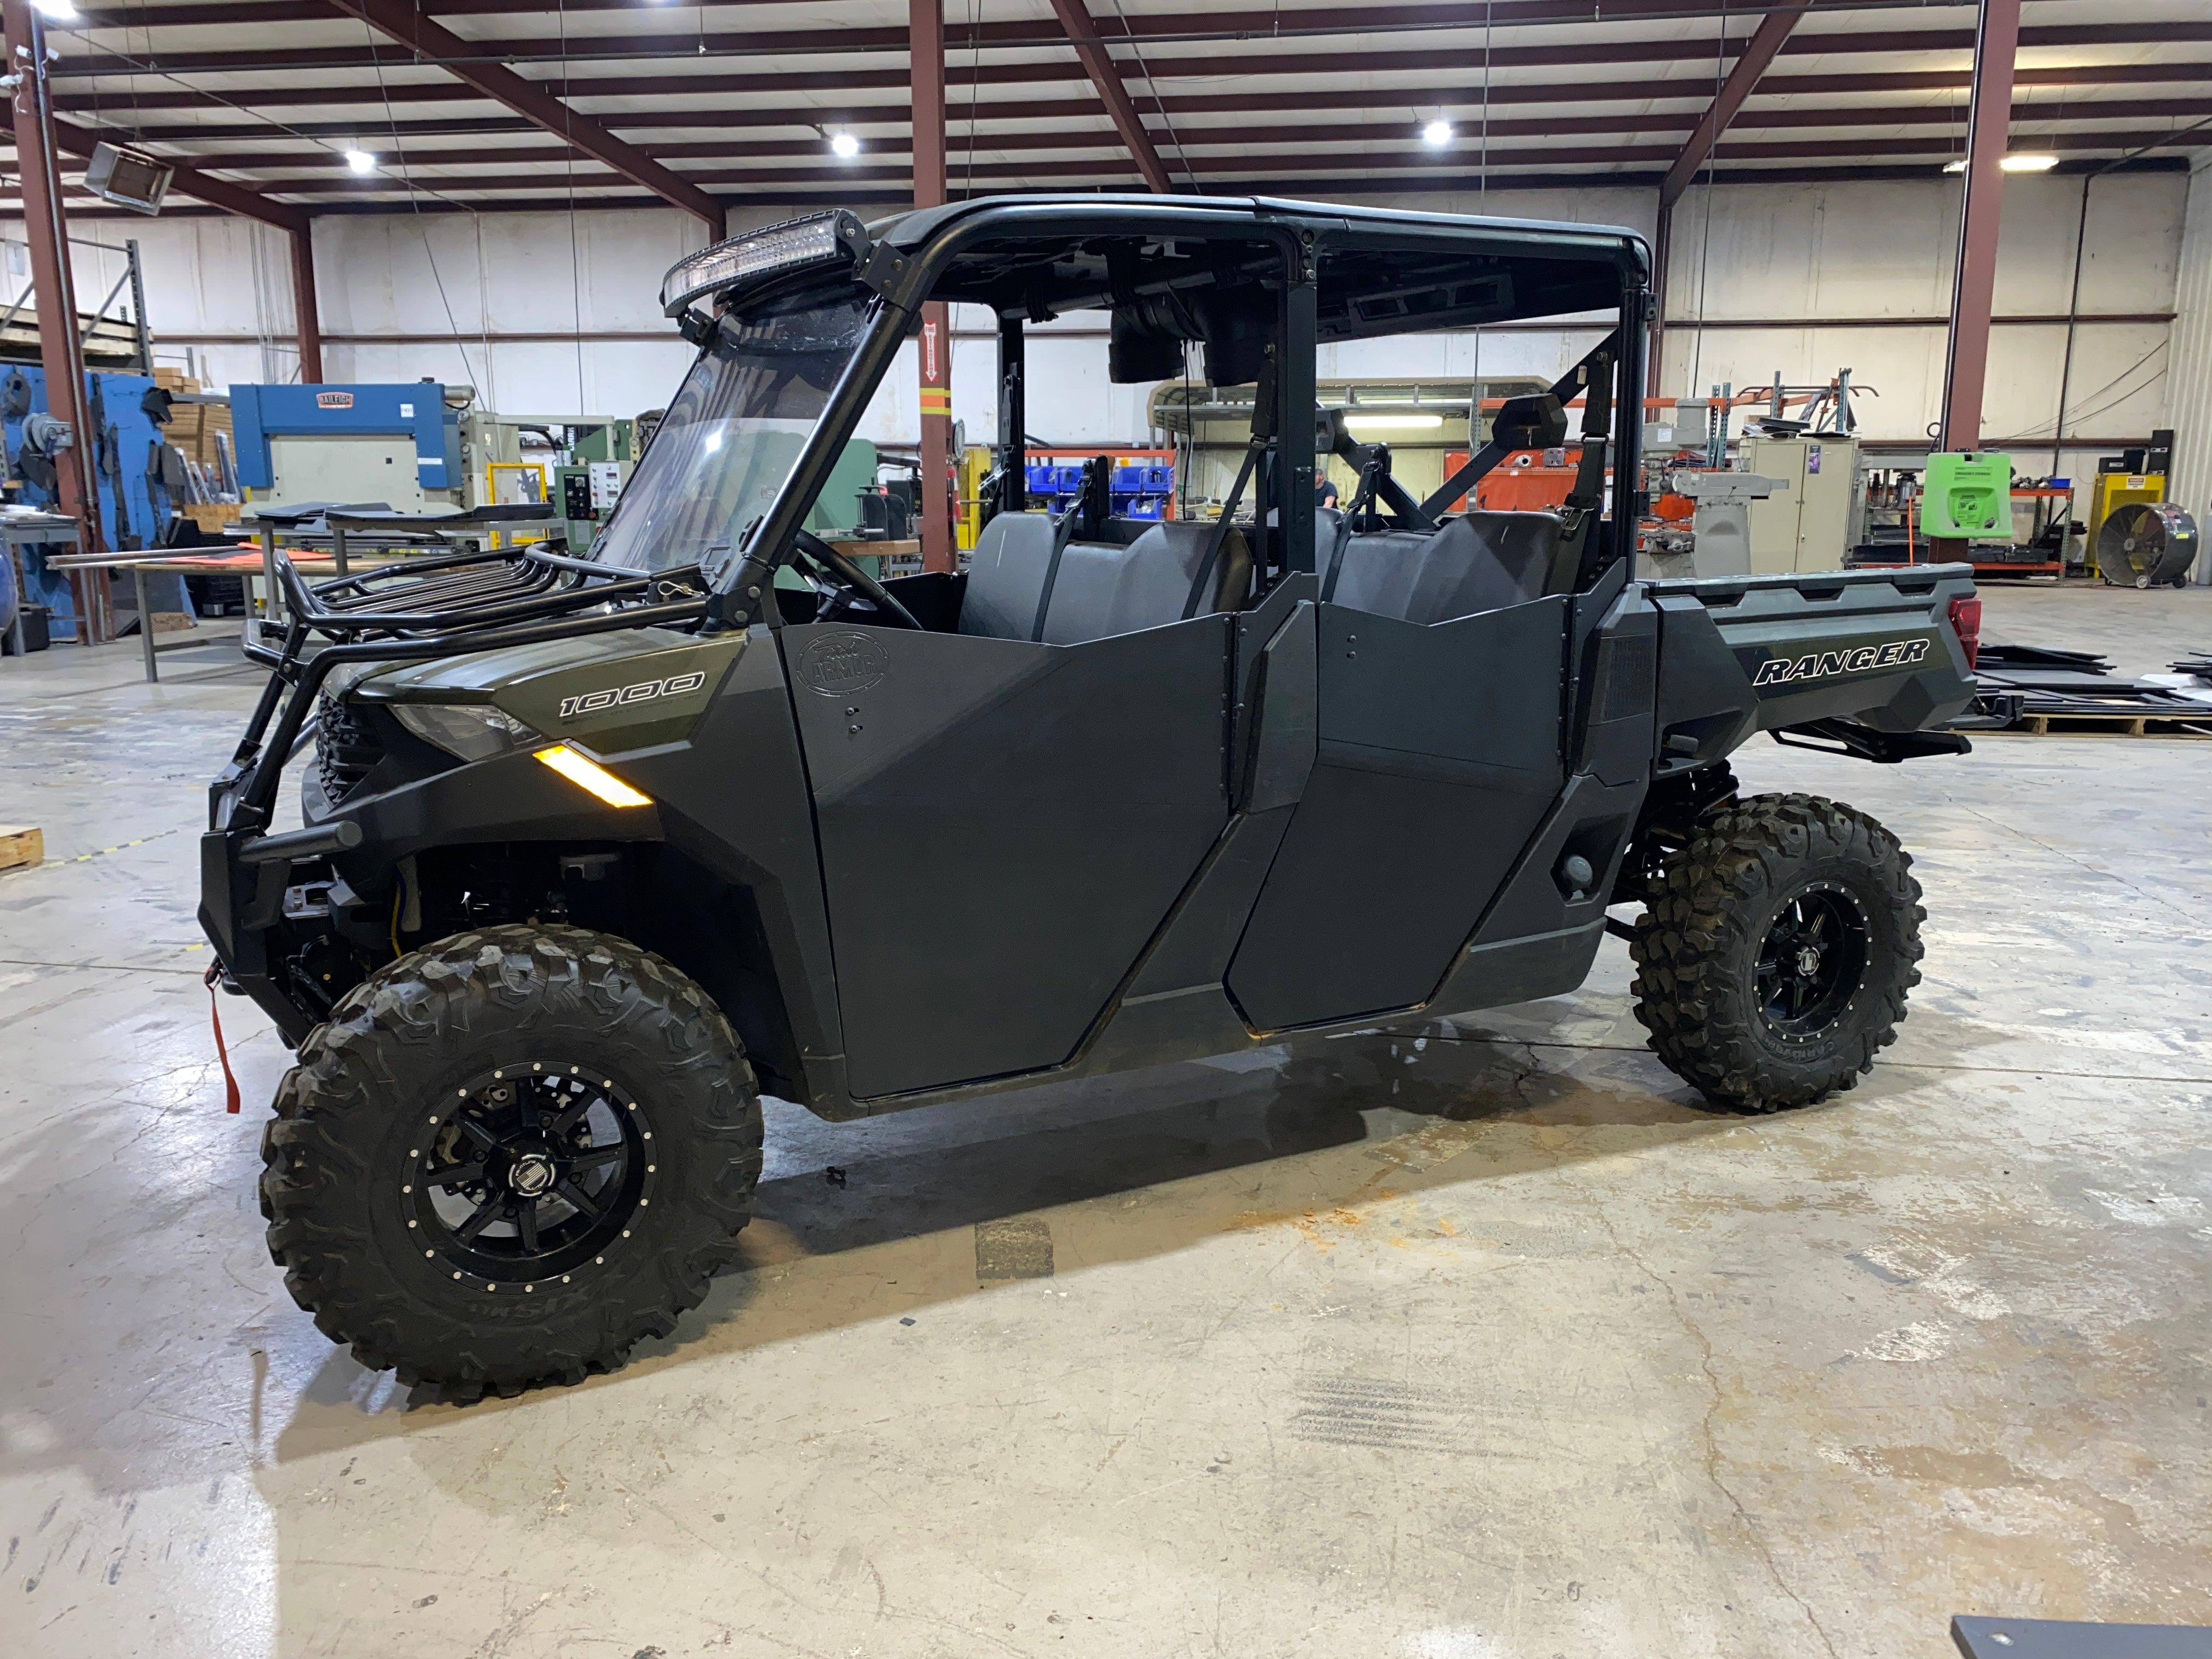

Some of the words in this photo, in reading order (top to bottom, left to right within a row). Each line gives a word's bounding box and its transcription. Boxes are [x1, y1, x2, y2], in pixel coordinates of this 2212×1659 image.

[319, 394, 351, 404] BAILEIGH
[812, 654, 879, 685] ARMOR
[1752, 639, 1929, 686] RANGER
[559, 671, 705, 718] 1000
